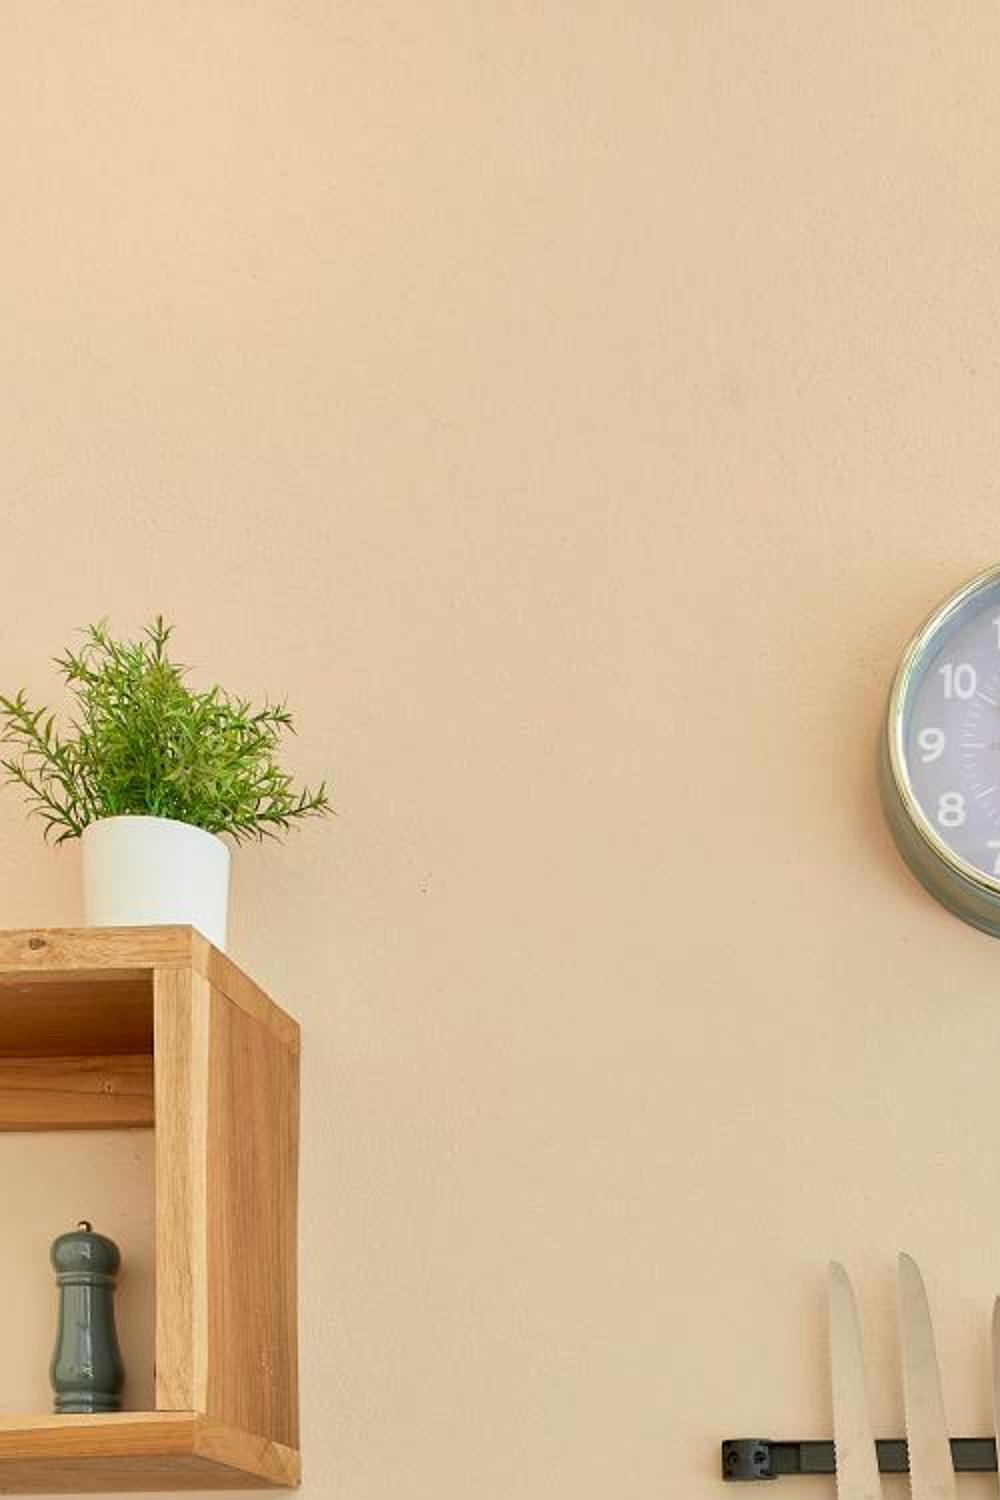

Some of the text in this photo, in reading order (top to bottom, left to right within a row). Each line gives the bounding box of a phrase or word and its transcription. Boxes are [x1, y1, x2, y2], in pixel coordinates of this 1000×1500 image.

[939, 663, 978, 699] 10
[917, 728, 946, 763] 9
[937, 792, 966, 827] 8
